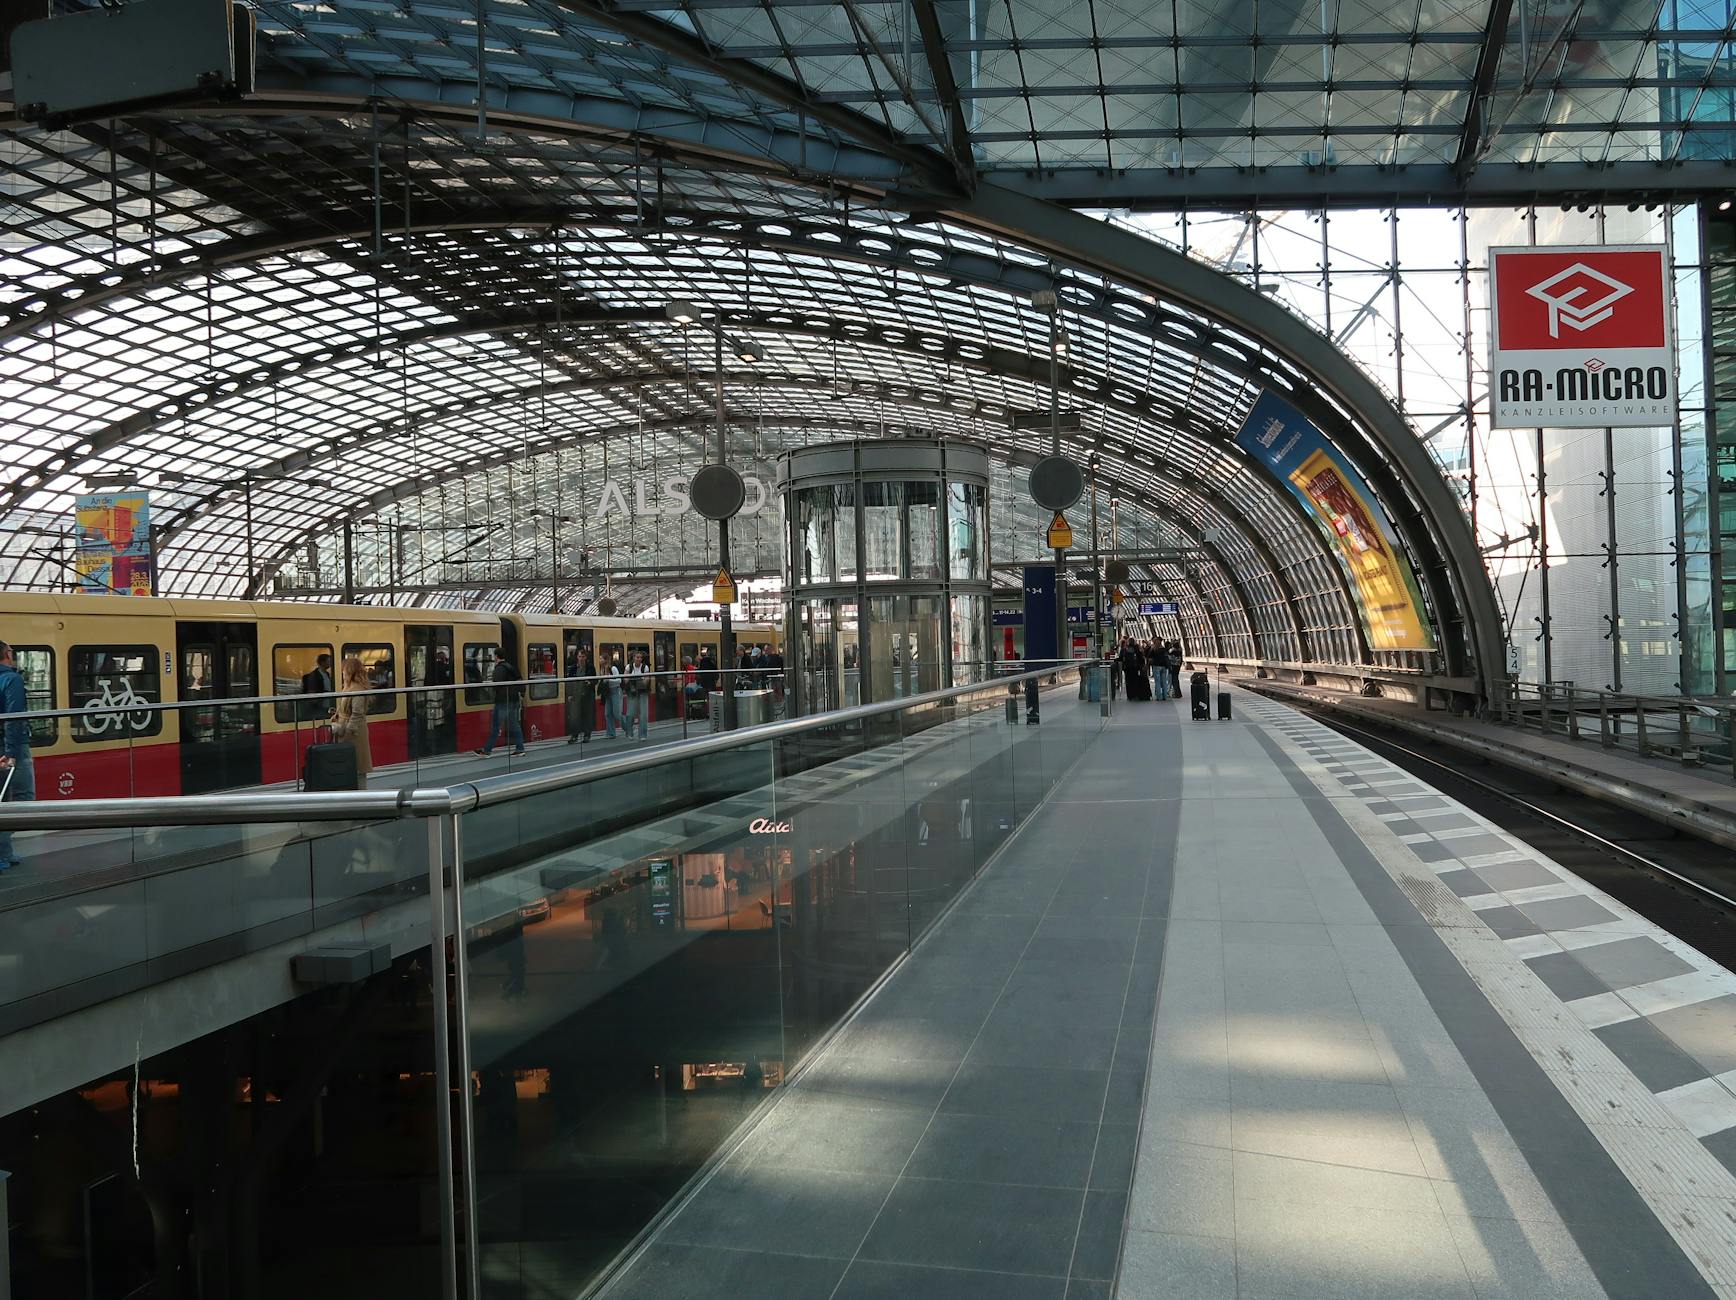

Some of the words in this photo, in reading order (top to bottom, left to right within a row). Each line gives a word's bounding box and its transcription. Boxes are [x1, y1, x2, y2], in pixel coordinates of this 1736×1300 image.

[1500, 405, 1669, 417] KANZLEISOFTWARE
[90, 497, 101, 505] An
[101, 497, 112, 505] die
[1142, 581, 1153, 591] 16
[1510, 648, 1518, 659] 5
[1511, 660, 1518, 669] 4
